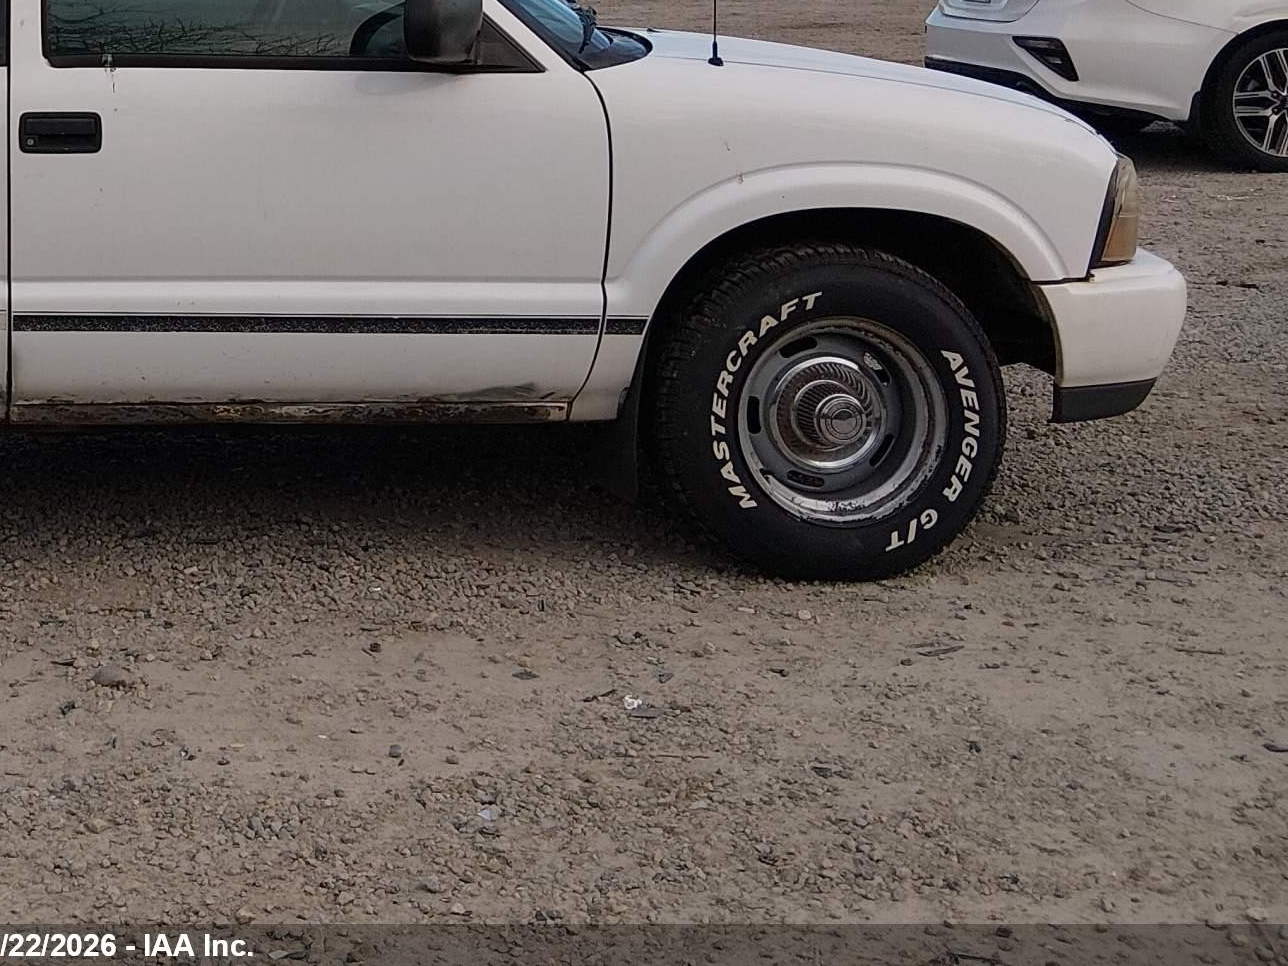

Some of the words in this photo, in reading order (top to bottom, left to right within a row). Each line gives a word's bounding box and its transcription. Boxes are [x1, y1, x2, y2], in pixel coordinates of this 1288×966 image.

[710, 291, 823, 509] MASTERCRAFT
[940, 348, 980, 503] AVENGER
[884, 508, 939, 552] G/T
